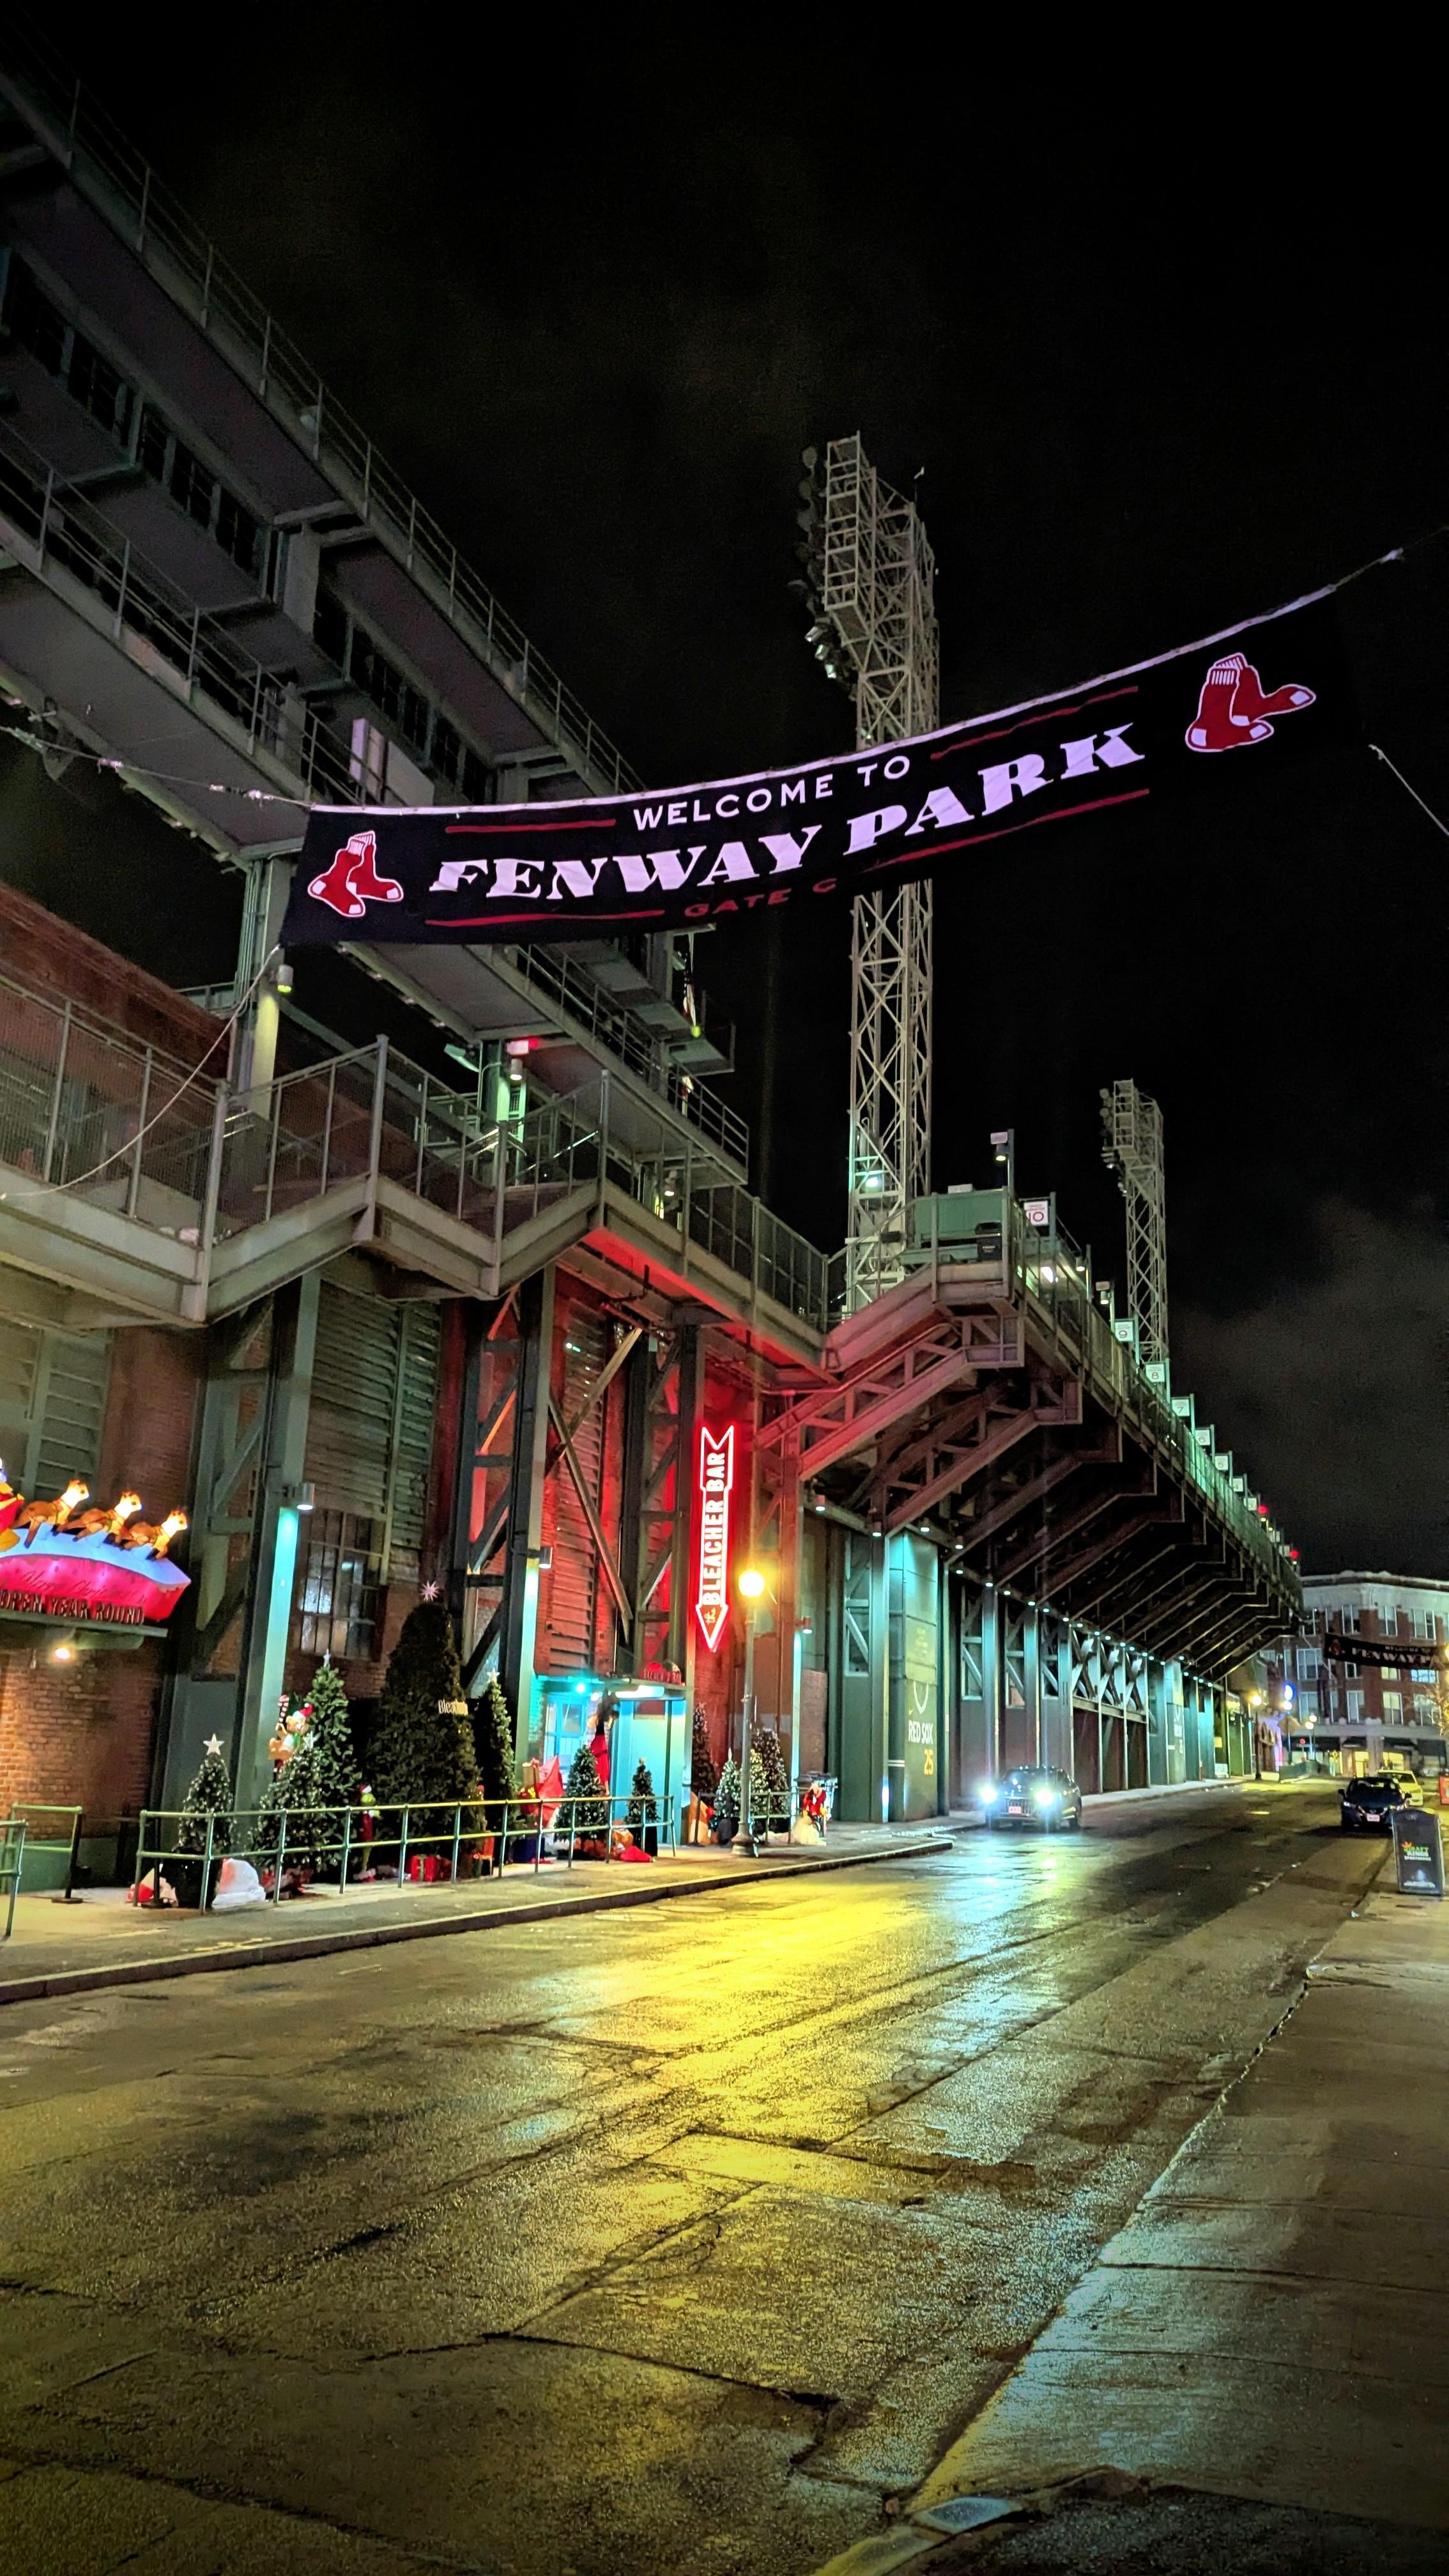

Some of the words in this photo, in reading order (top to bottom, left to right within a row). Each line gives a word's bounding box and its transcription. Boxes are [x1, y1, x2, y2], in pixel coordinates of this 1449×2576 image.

[633, 774, 833, 831] WELCOME
[857, 755, 910, 786] TO
[429, 824, 822, 900] FENWAY
[843, 723, 1145, 855] PARK
[684, 888, 792, 917] GATE
[1029, 1211, 1044, 1222] 10
[1119, 1330, 1128, 1338] 9
[1151, 1372, 1159, 1380] 8
[705, 1452, 726, 1492] BAR
[702, 1499, 724, 1606] BLEACHER
[50, 1595, 90, 1620] YEAR
[96, 1600, 145, 1626] ROUND
[908, 1719, 921, 1743] RED
[921, 1722, 933, 1744] SOX
[923, 1749, 933, 1775] 25
